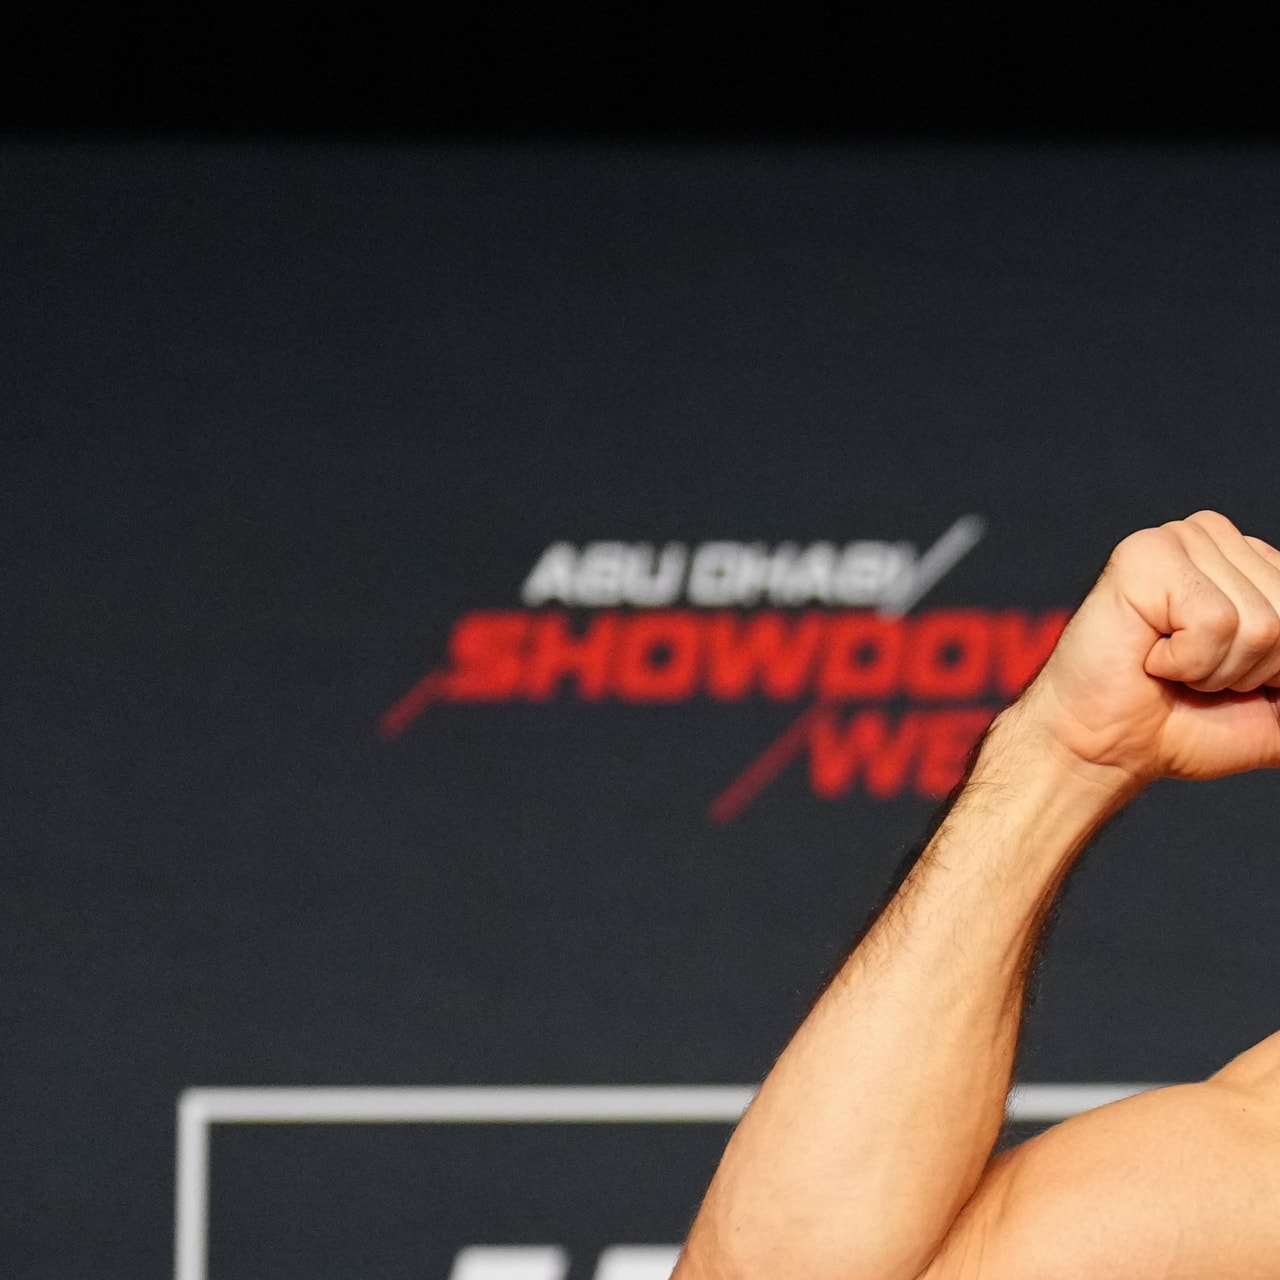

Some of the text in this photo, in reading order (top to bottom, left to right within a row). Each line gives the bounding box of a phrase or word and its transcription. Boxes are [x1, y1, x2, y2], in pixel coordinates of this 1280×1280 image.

[523, 541, 917, 606] ABU DHABI
[450, 610, 1074, 702] SHOWDO
[808, 708, 998, 800] WE
